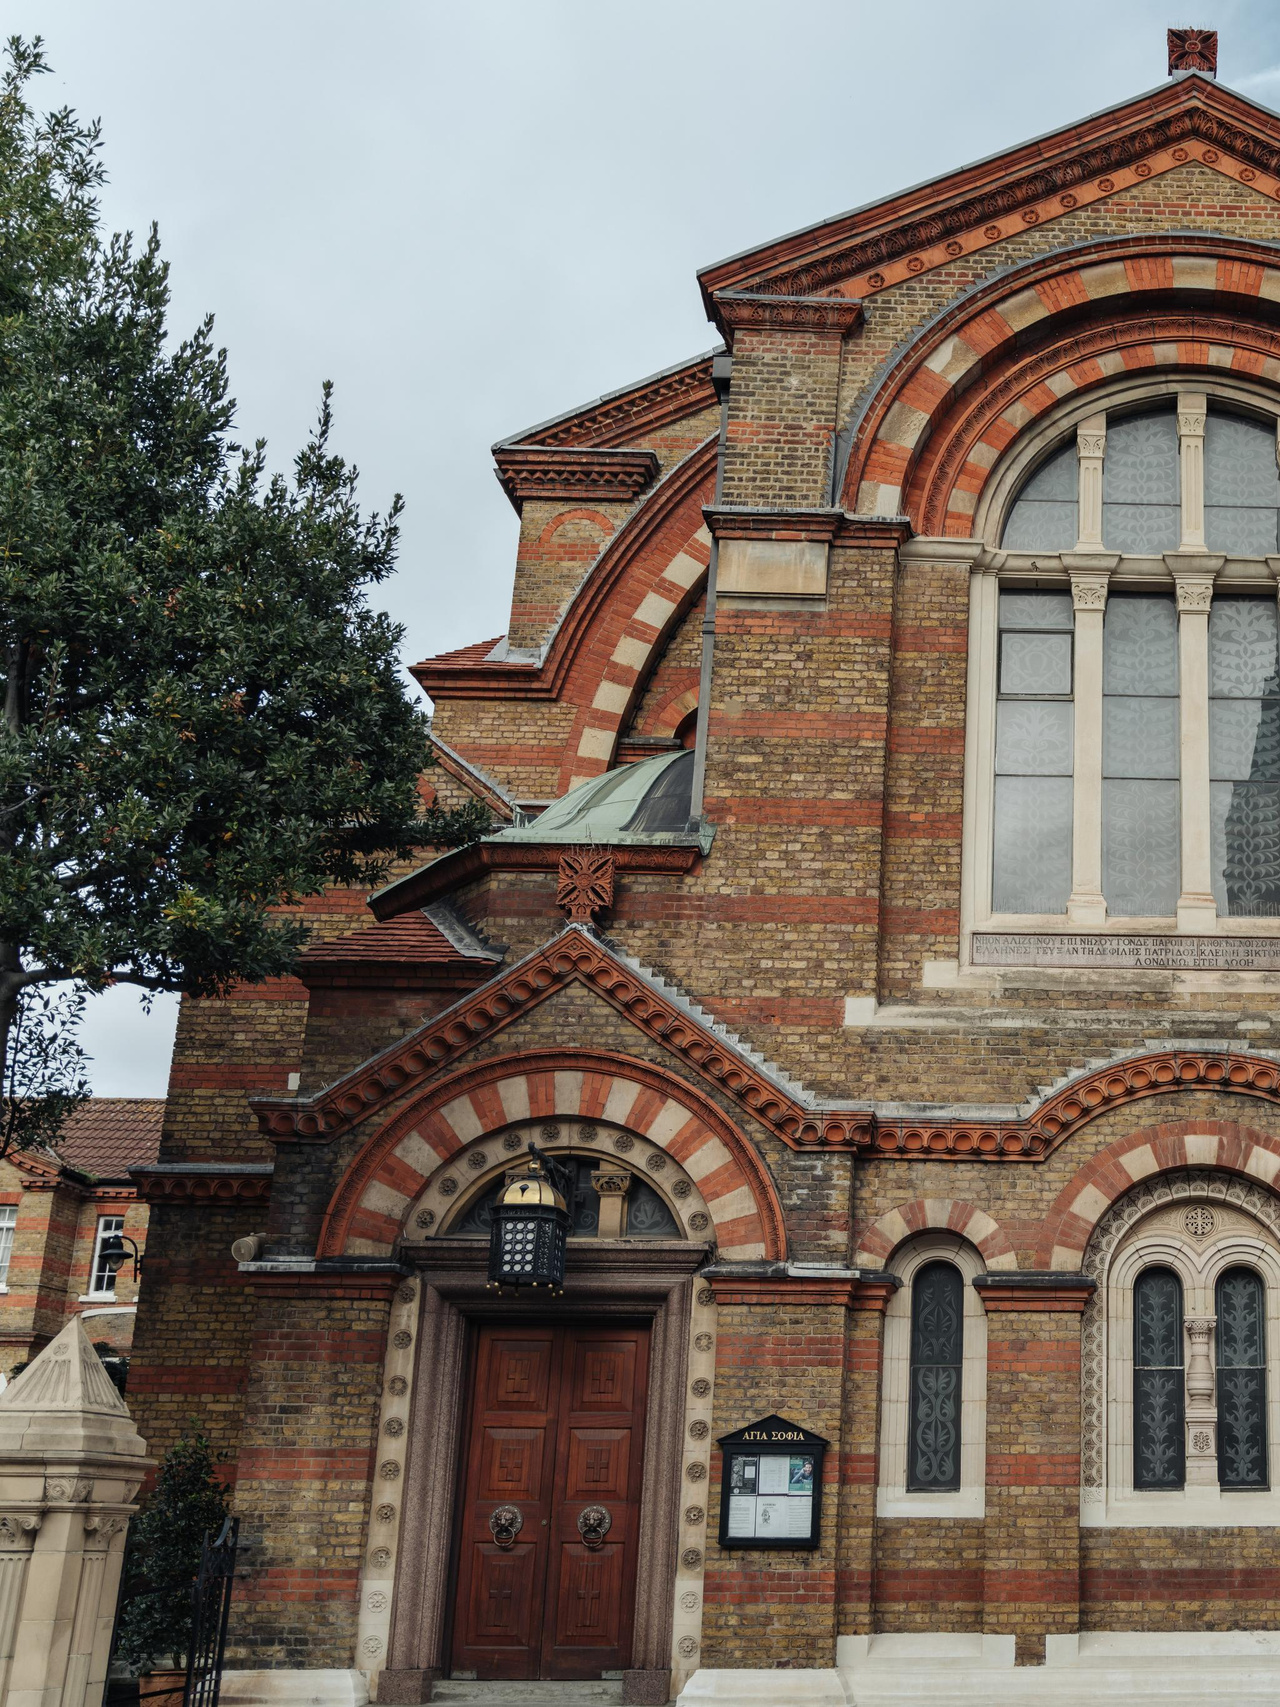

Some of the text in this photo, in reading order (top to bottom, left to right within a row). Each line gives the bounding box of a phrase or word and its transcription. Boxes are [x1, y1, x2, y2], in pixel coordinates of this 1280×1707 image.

[1060, 937, 1077, 945] ΕΠΙ
[1144, 948, 1196, 957] ΠΑΤΡΙΔΟΣ
[1193, 958, 1218, 967] ΕΤΕΙ
[742, 1431, 805, 1440] ΑΓΙΑ ΣΟΦΙΑ
